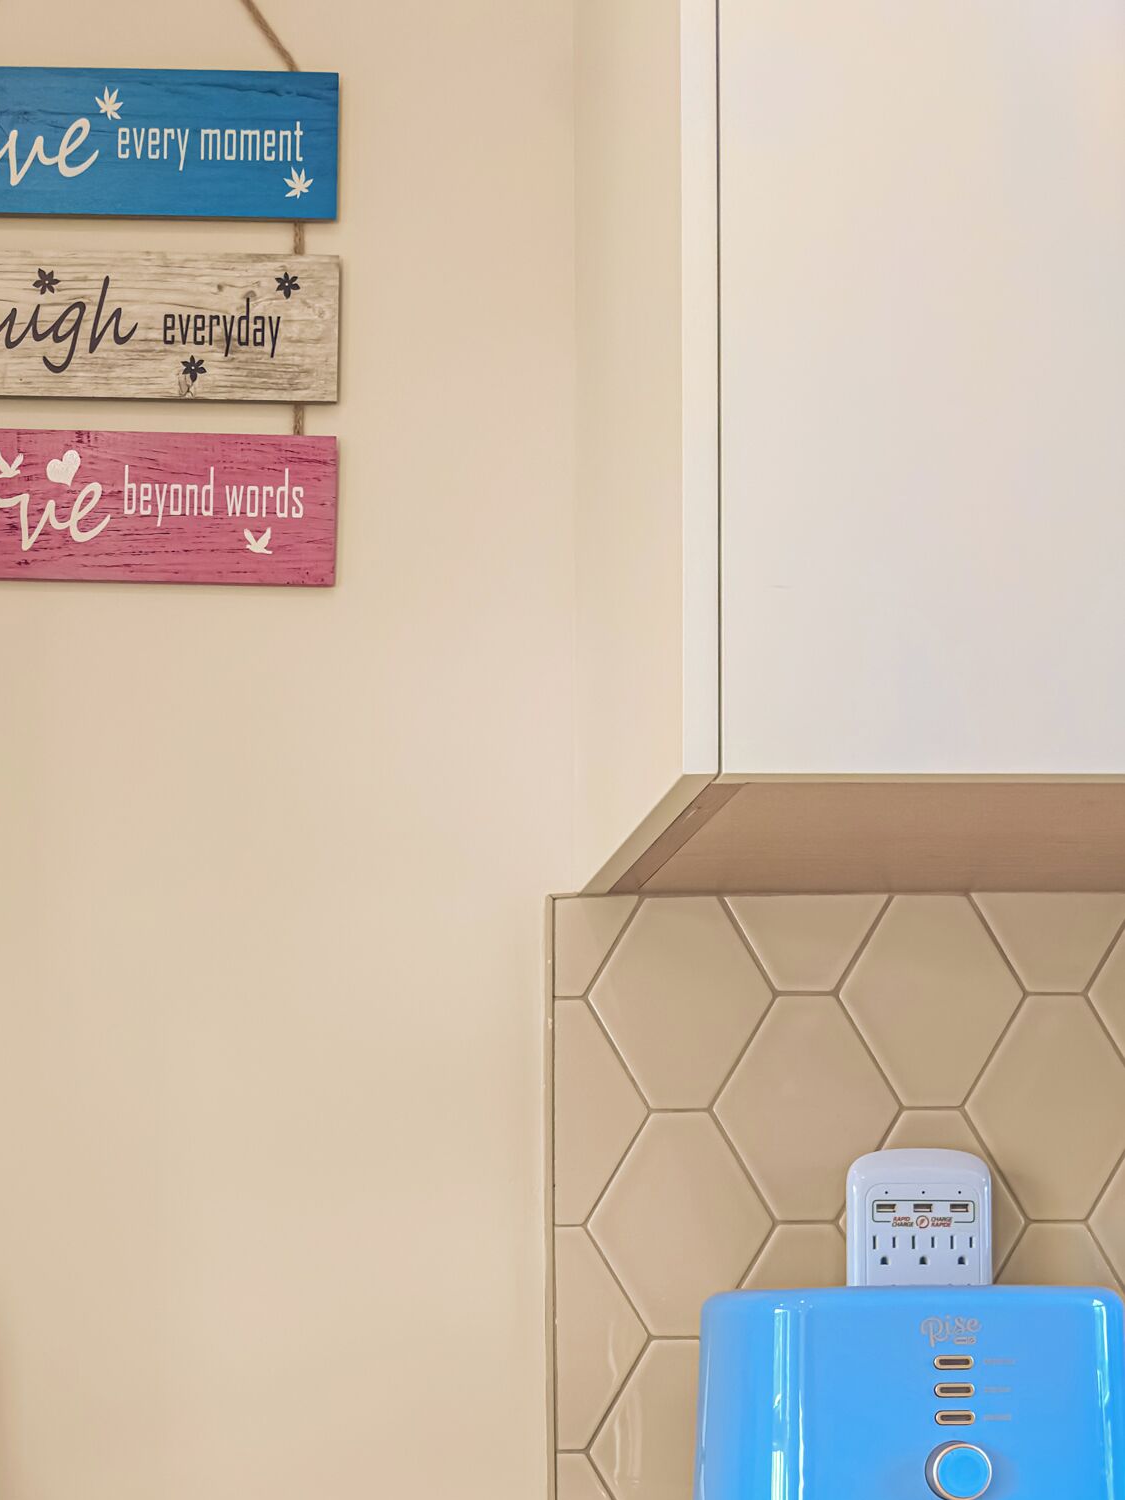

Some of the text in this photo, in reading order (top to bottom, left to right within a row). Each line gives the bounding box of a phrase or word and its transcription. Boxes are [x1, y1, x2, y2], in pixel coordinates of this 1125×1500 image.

[117, 126, 188, 171] every
[200, 121, 304, 163] moment
[162, 297, 281, 358] everyday
[123, 465, 215, 527] beyond
[225, 467, 305, 519] words
[920, 1314, 981, 1348] Rise
